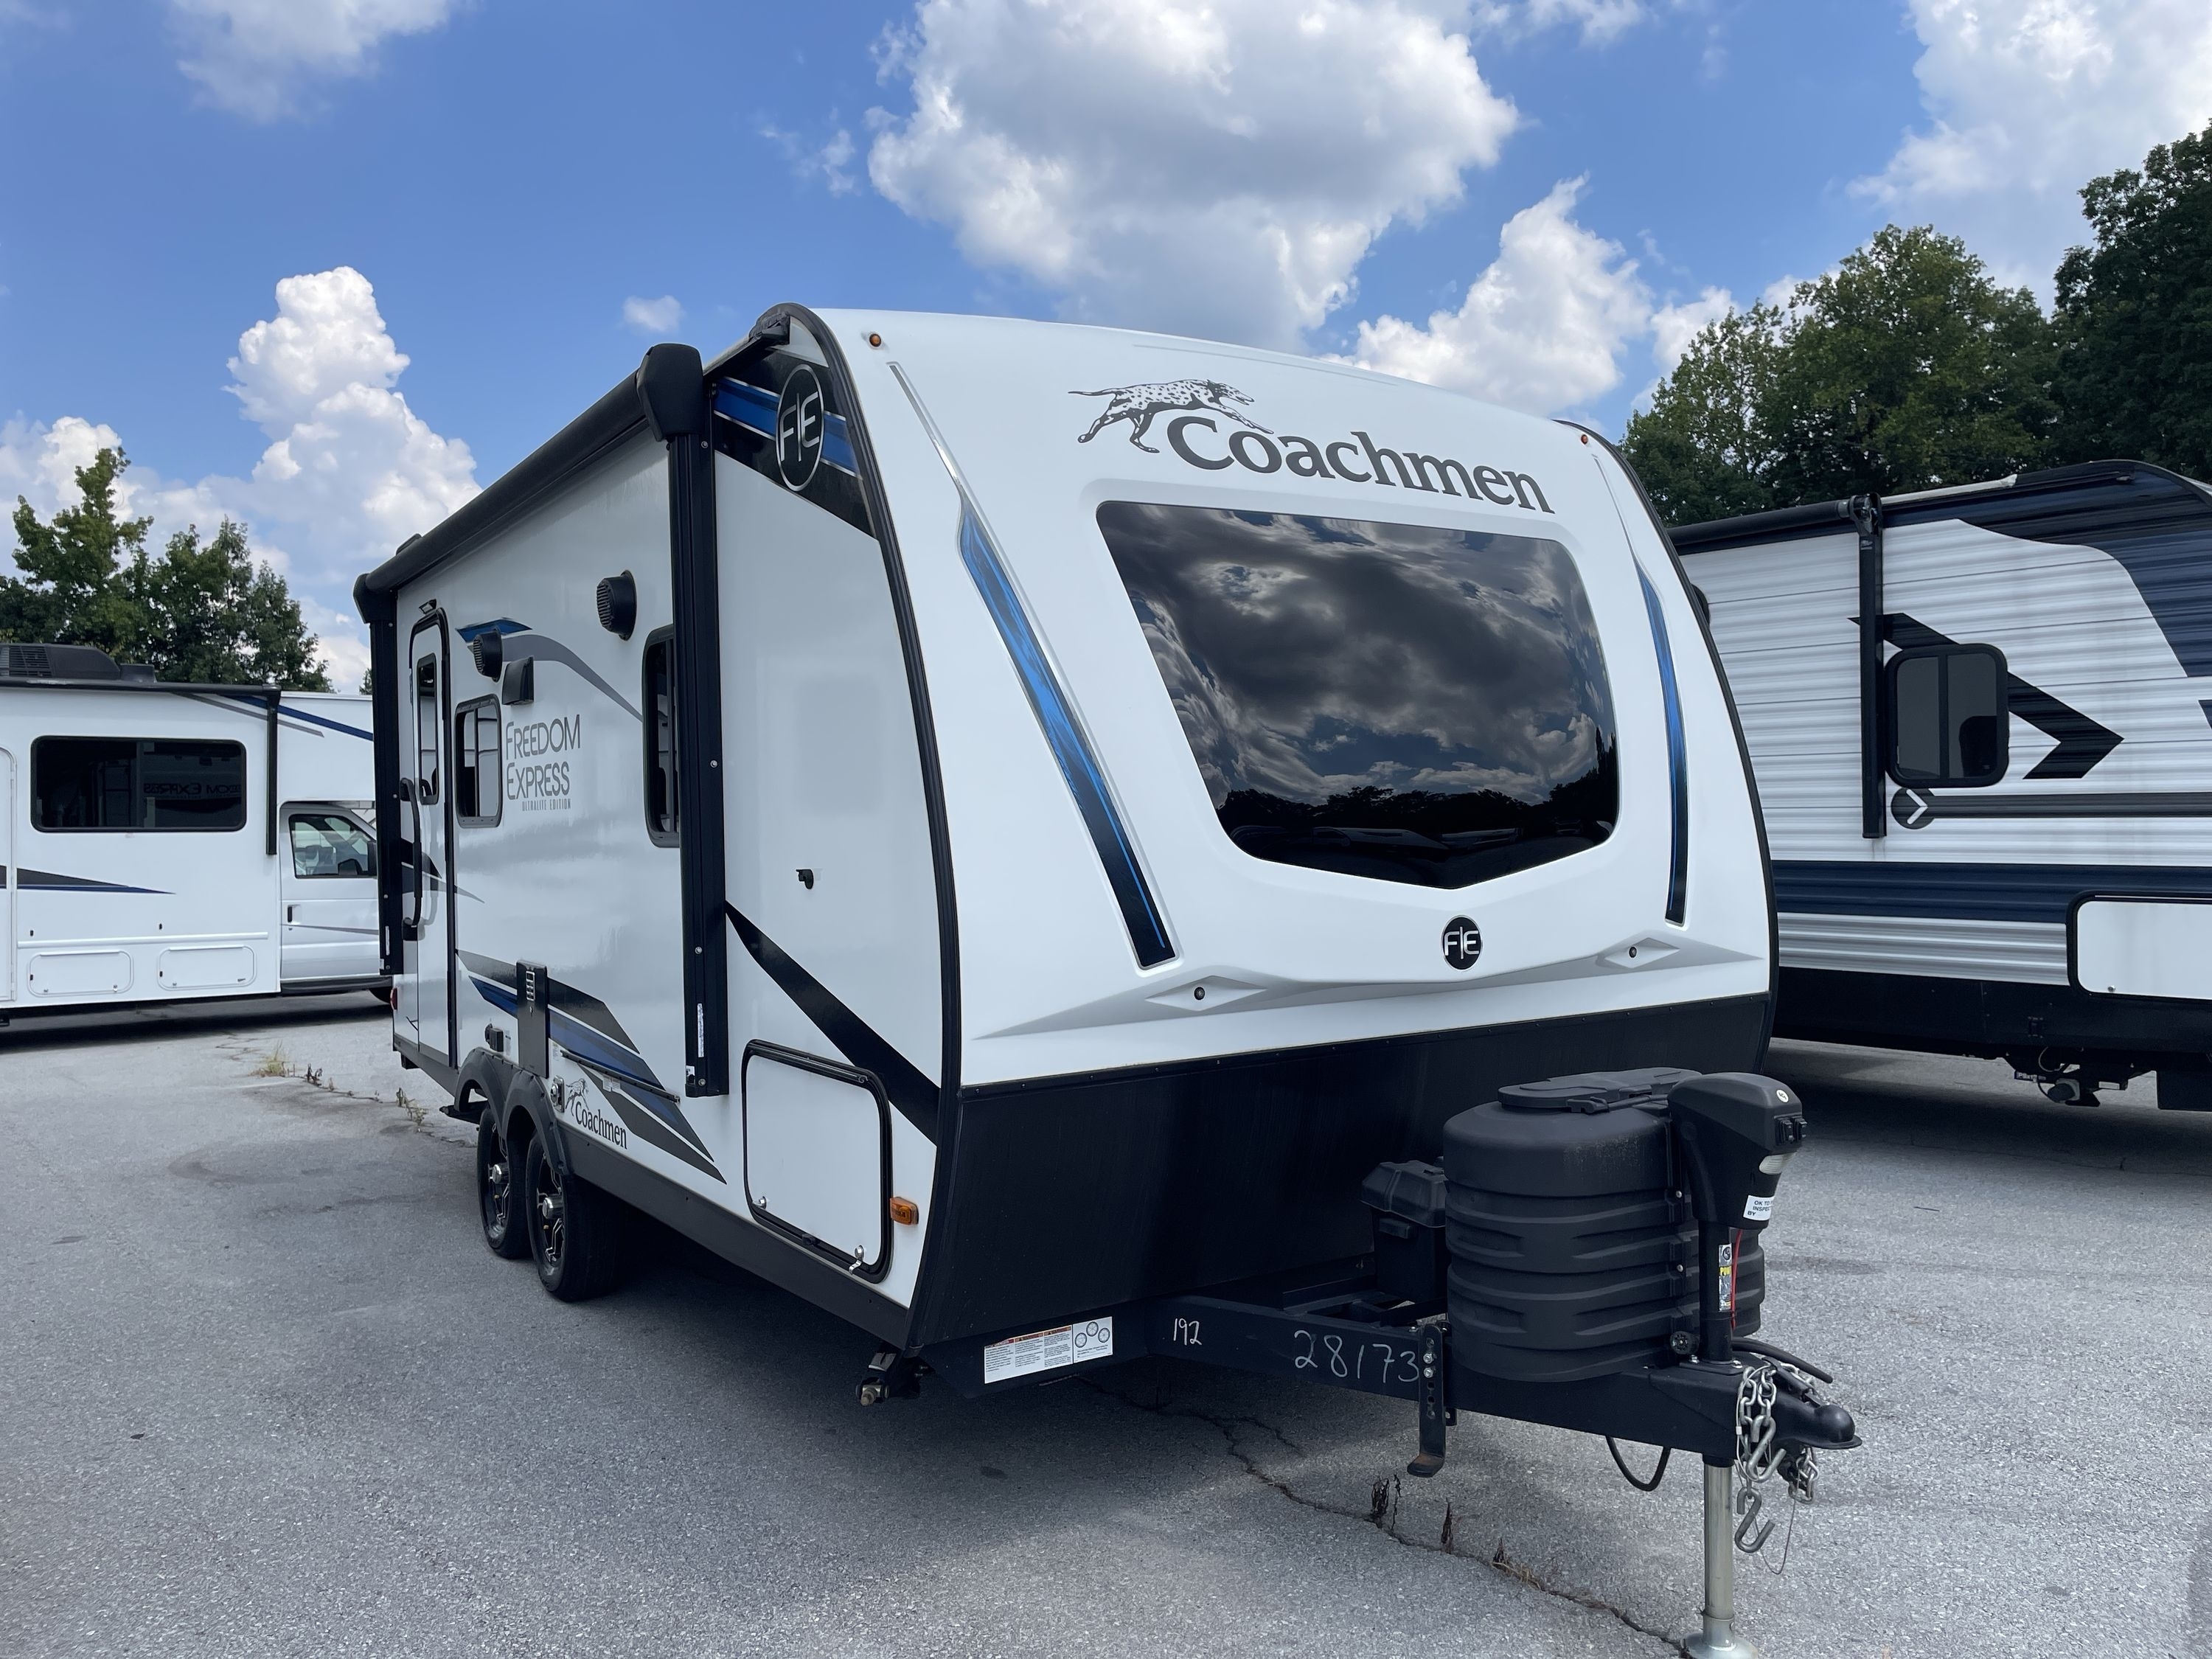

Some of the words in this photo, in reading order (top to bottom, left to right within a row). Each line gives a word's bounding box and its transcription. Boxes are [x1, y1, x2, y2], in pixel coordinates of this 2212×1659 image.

[1166, 416, 1555, 514] Coachmen
[506, 714, 580, 760] FREEDOM
[507, 761, 570, 800] EXPRESS
[550, 799, 571, 810] EDITION
[575, 1101, 627, 1149] Coachmen
[1173, 1318, 1203, 1346] 192
[1294, 1329, 1420, 1382] 28173
